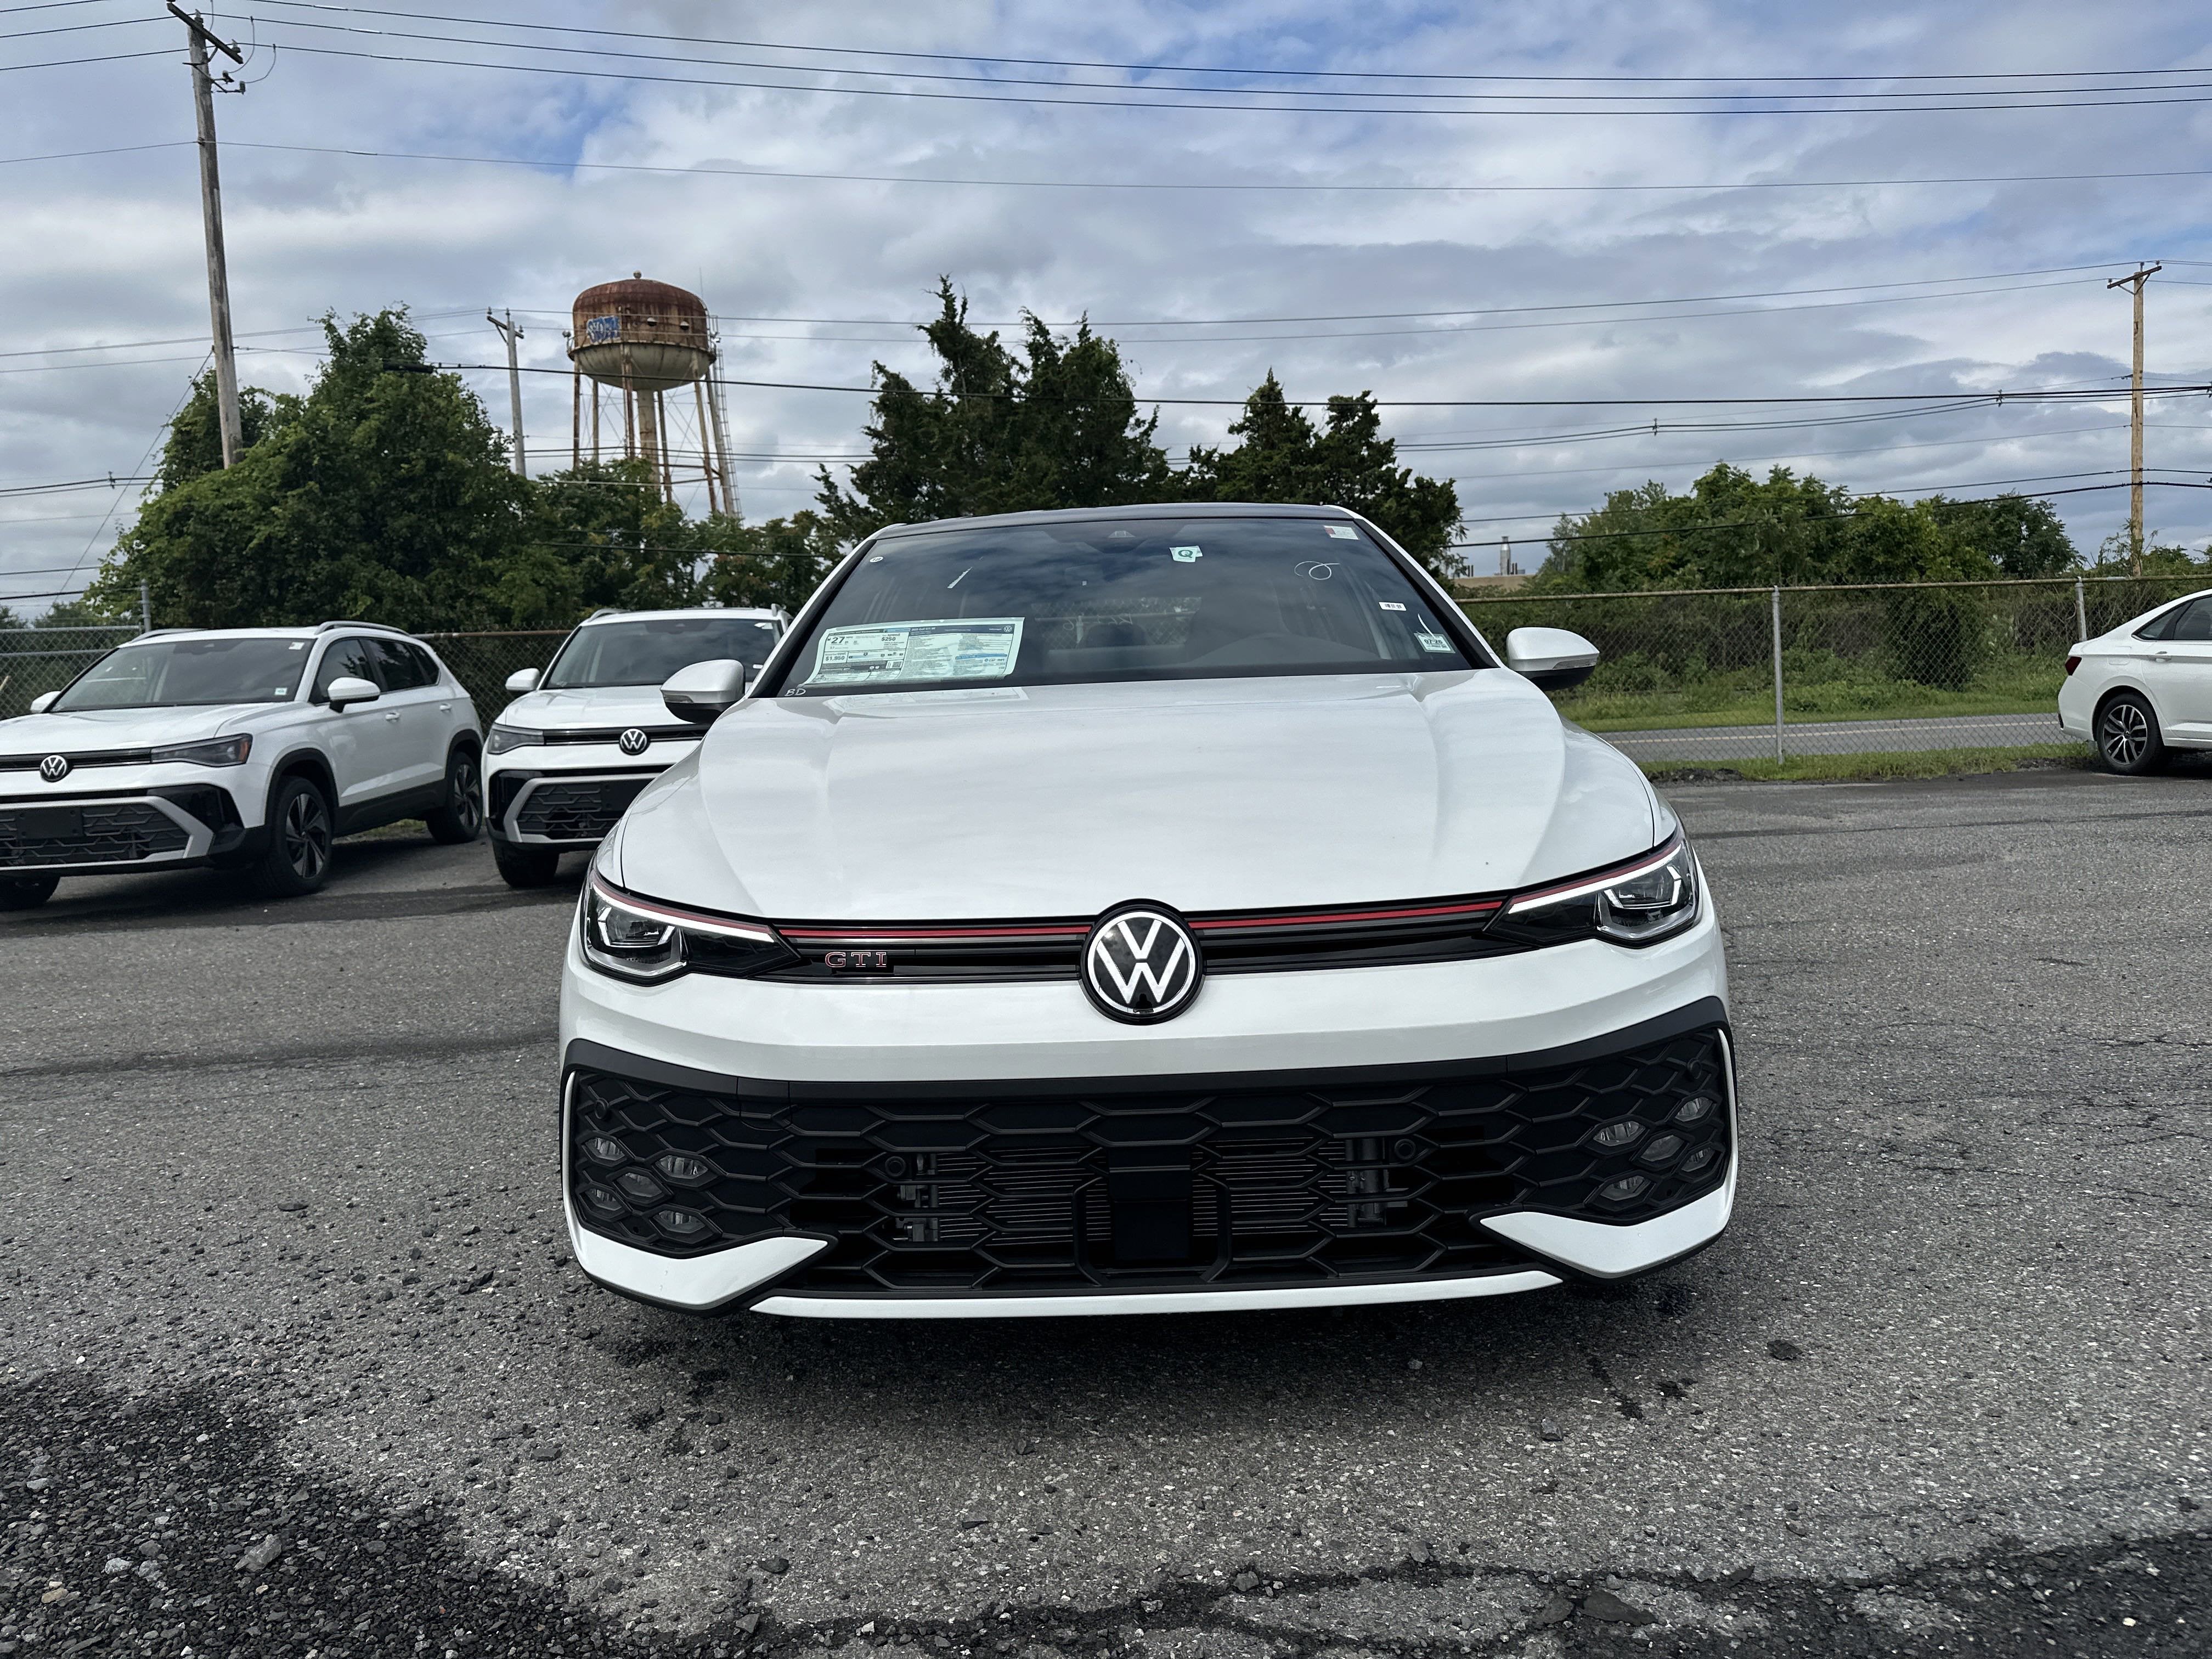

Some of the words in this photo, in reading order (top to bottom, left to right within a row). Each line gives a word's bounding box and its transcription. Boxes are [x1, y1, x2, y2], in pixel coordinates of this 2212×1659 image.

[1178, 550, 1193, 558] Q
[785, 688, 806, 696] BD
[620, 729, 647, 752] VW
[41, 755, 66, 778] VW
[825, 952, 887, 968] GTI
[1088, 911, 1195, 1013] VW
